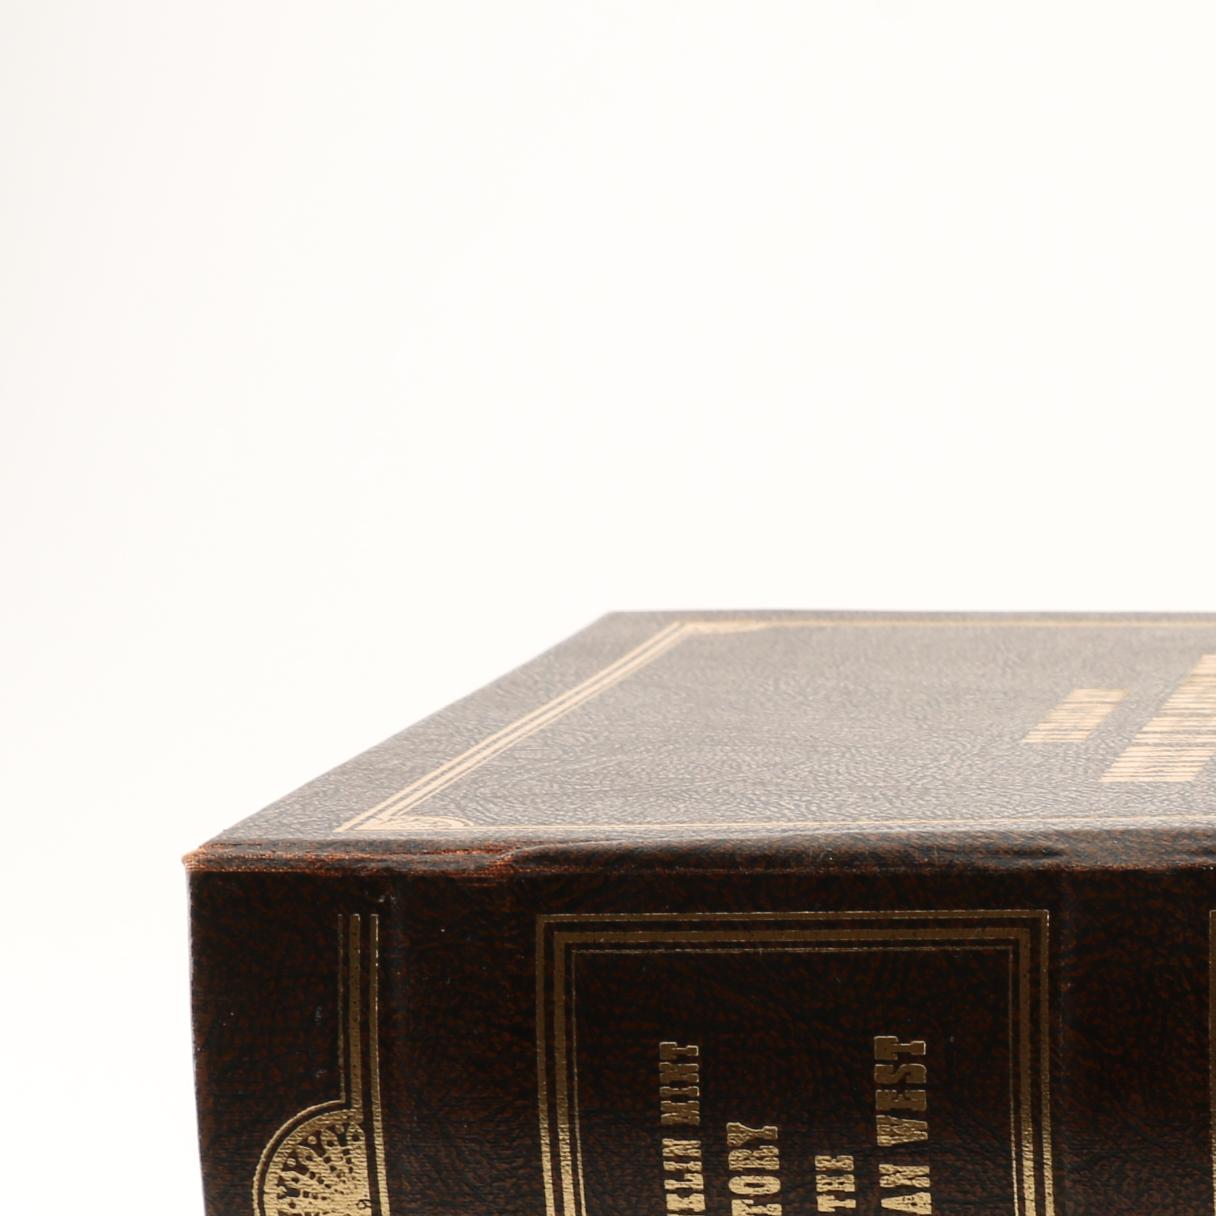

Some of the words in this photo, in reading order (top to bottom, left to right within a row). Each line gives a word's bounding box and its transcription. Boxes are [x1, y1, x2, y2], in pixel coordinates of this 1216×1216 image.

[659, 1042, 699, 1125] MINT
[874, 1036, 928, 1147] WEST
[815, 1155, 855, 1212] THE
